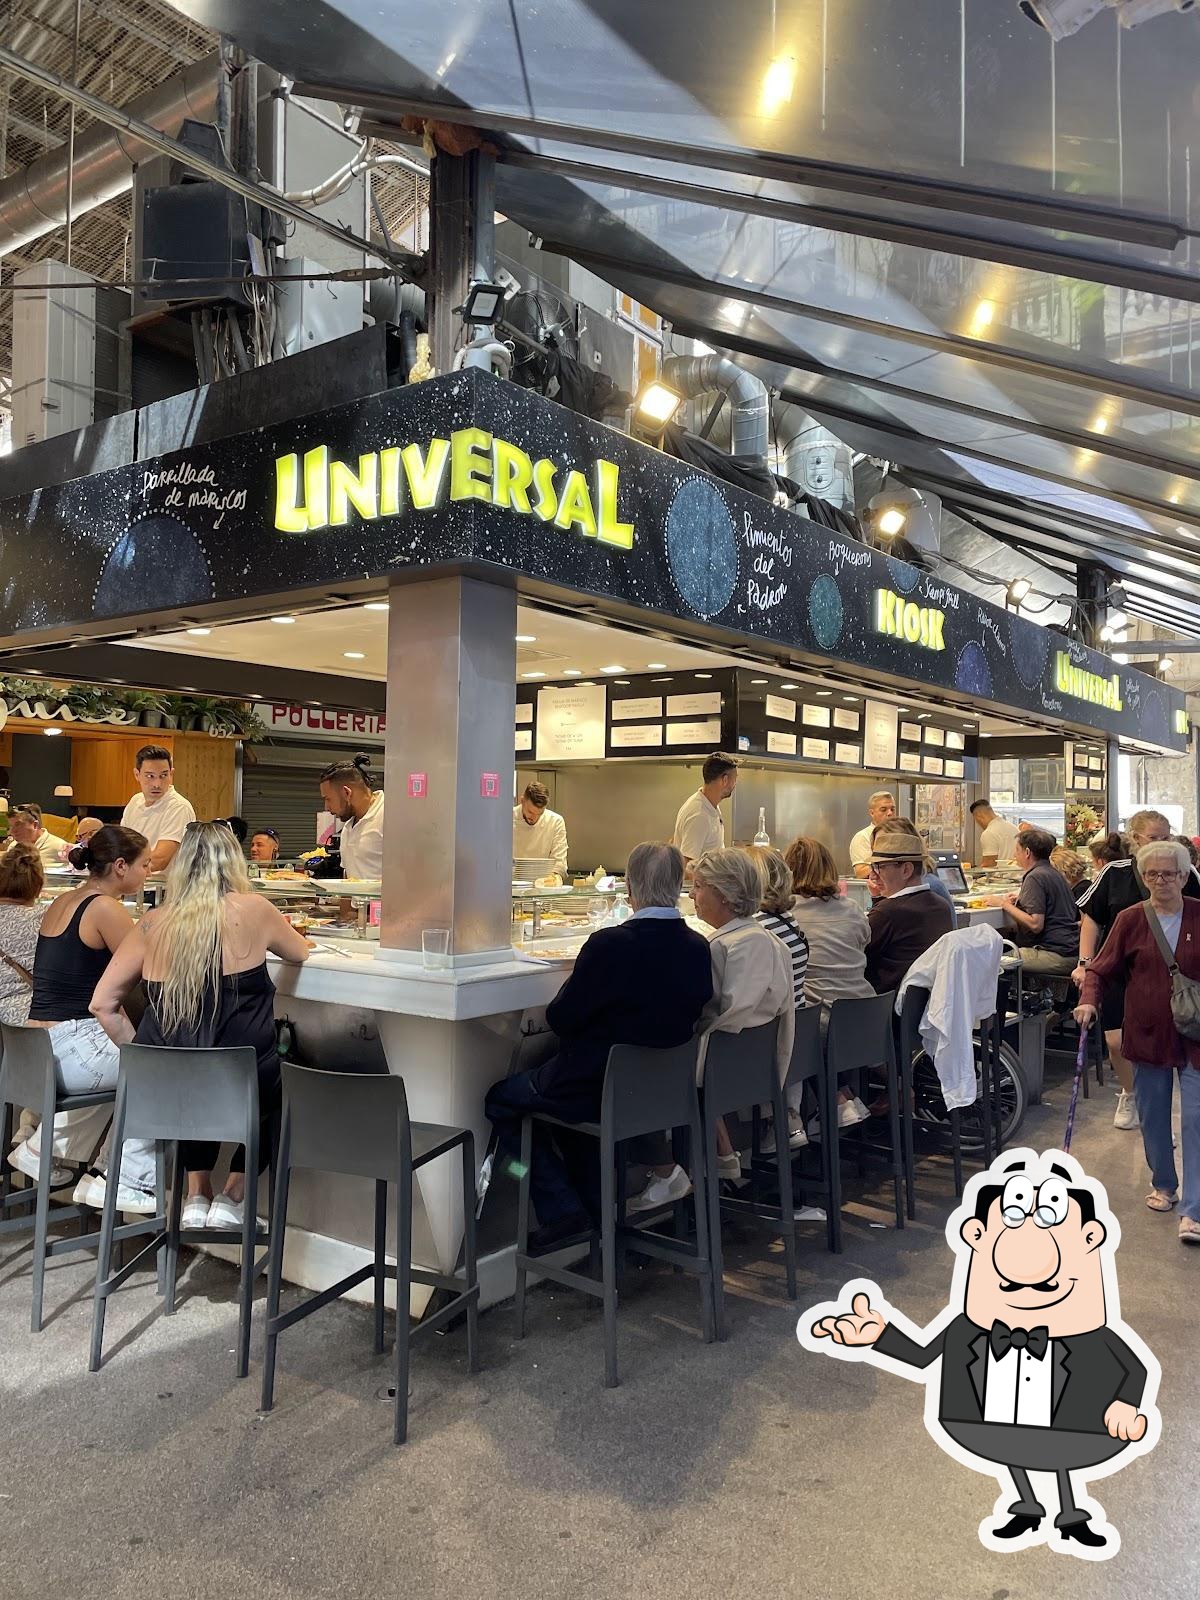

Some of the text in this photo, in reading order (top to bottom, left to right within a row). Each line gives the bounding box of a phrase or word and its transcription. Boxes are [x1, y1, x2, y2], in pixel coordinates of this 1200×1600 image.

[165, 487, 184, 506] de
[274, 427, 635, 550] UNIVERSAL
[753, 553, 775, 580] del
[877, 588, 946, 651] KIOSK
